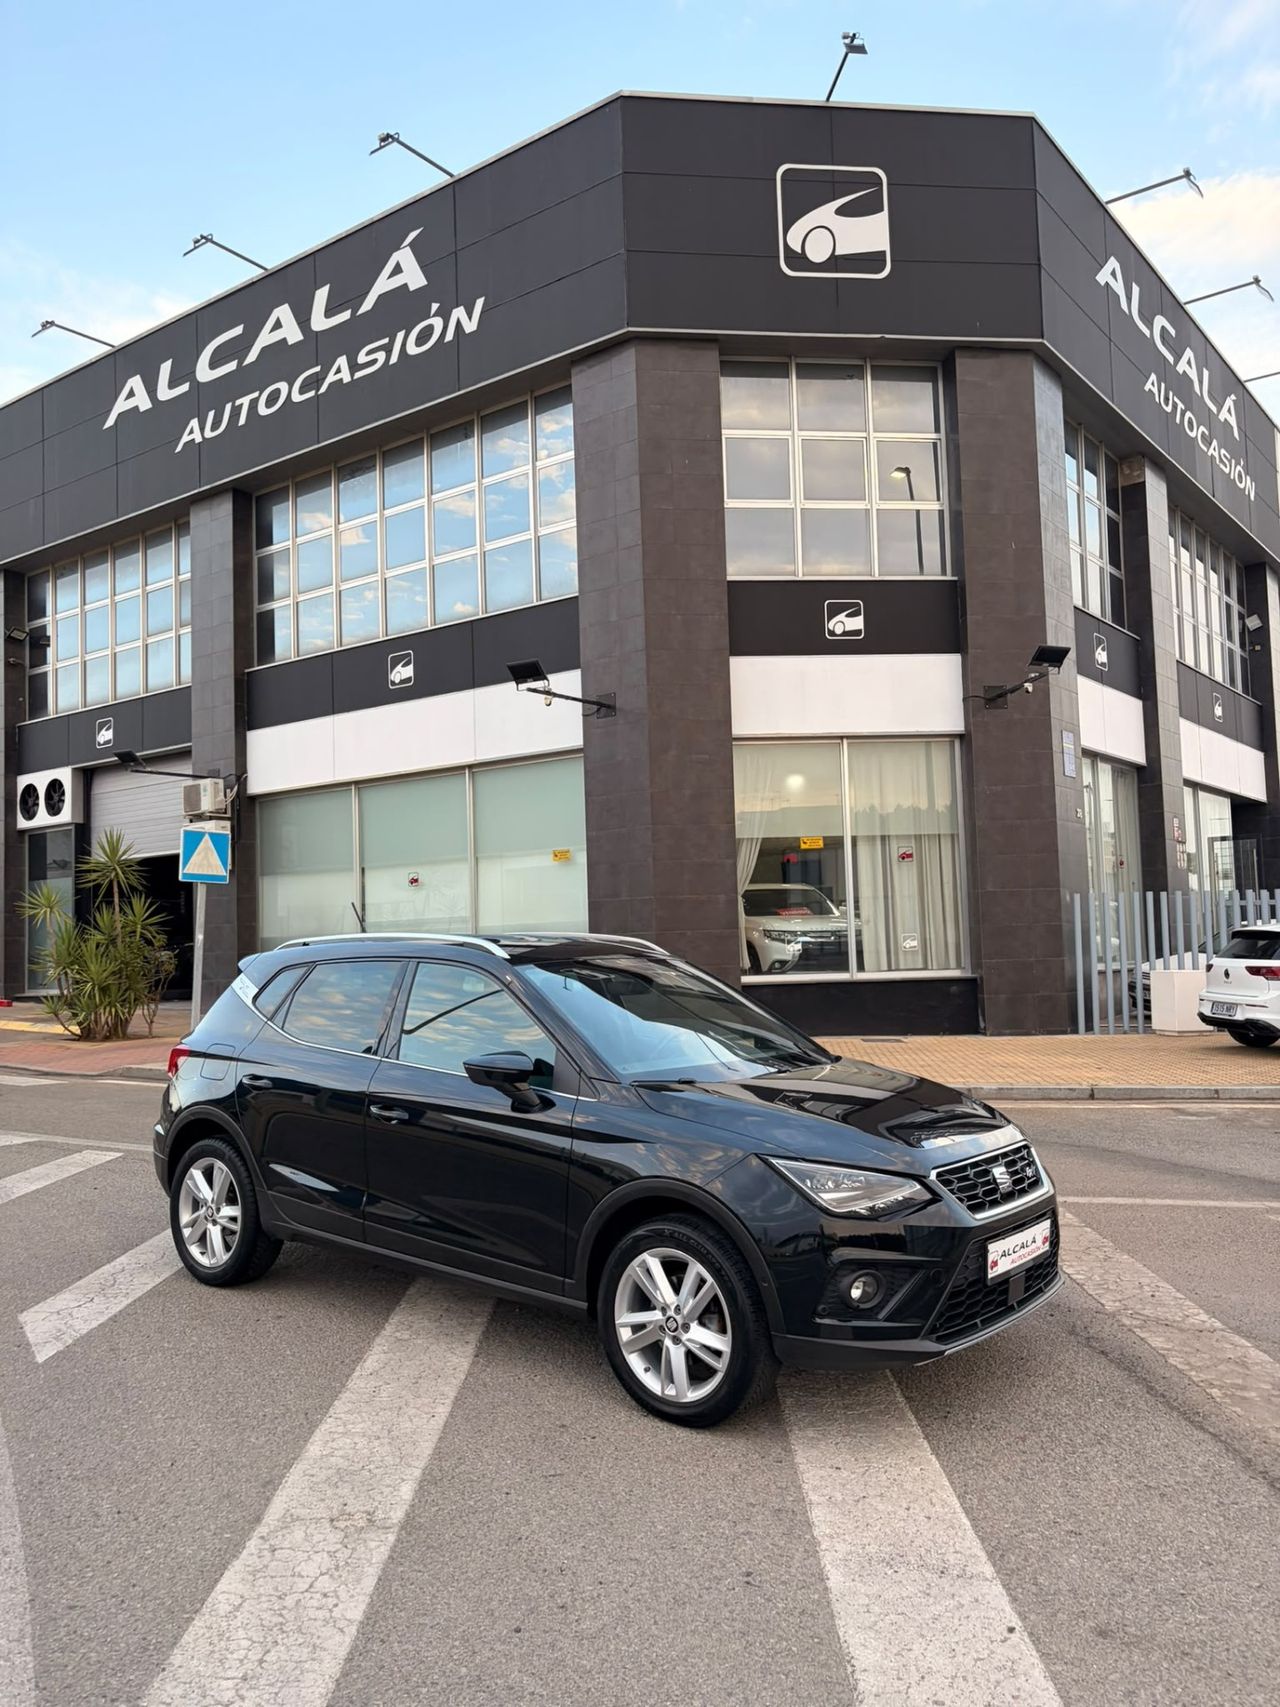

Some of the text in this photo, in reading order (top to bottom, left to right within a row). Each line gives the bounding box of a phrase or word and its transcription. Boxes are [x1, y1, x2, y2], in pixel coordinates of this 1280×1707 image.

[103, 227, 428, 430] ALCALÁ
[175, 296, 485, 454] AUTOCASIÓN
[1095, 255, 1240, 442] ALCALÁ
[1143, 372, 1257, 502] AUTOCASIÓN
[999, 1233, 1037, 1260] ALCALÁ
